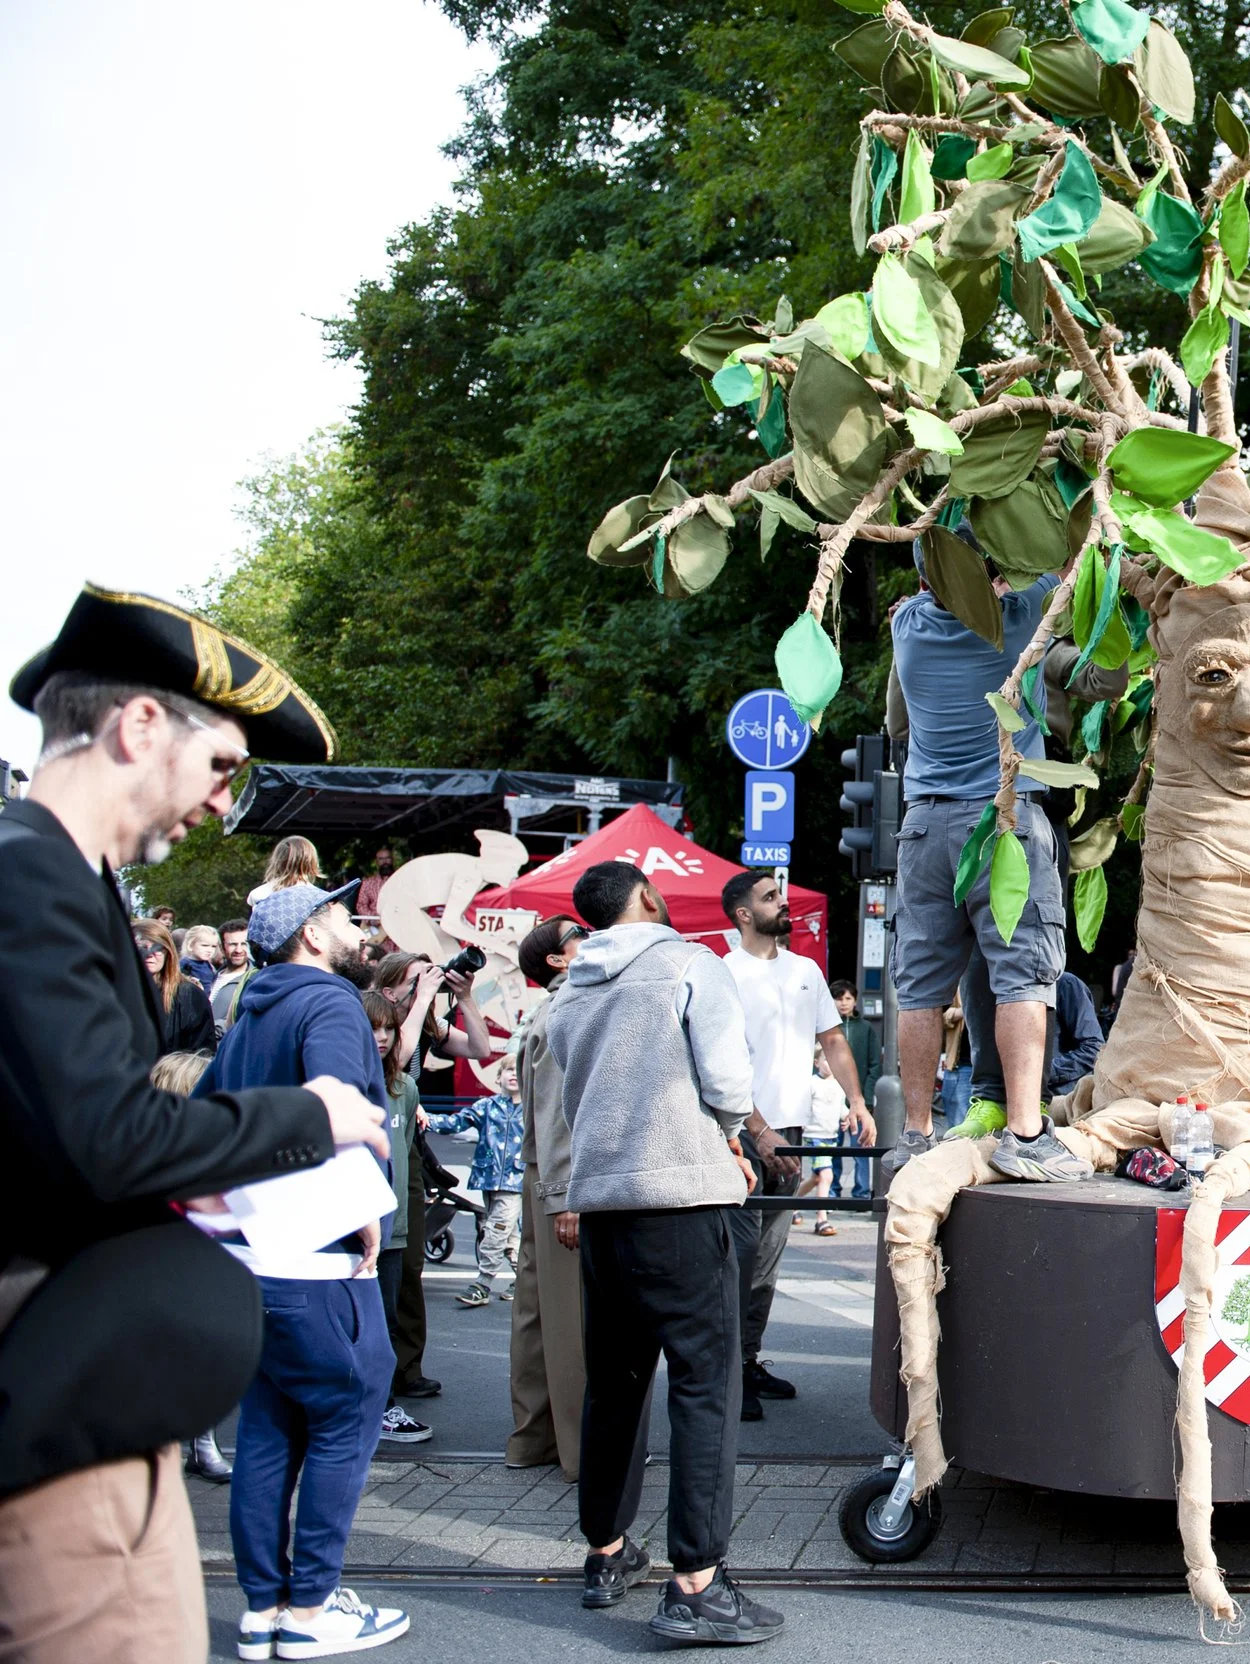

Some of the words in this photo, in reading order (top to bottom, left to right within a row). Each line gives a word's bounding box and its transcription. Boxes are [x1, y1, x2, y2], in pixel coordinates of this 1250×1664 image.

[752, 782, 787, 831] P
[641, 847, 690, 876] A
[744, 846, 788, 862] TAXIS
[478, 915, 504, 932] STA
